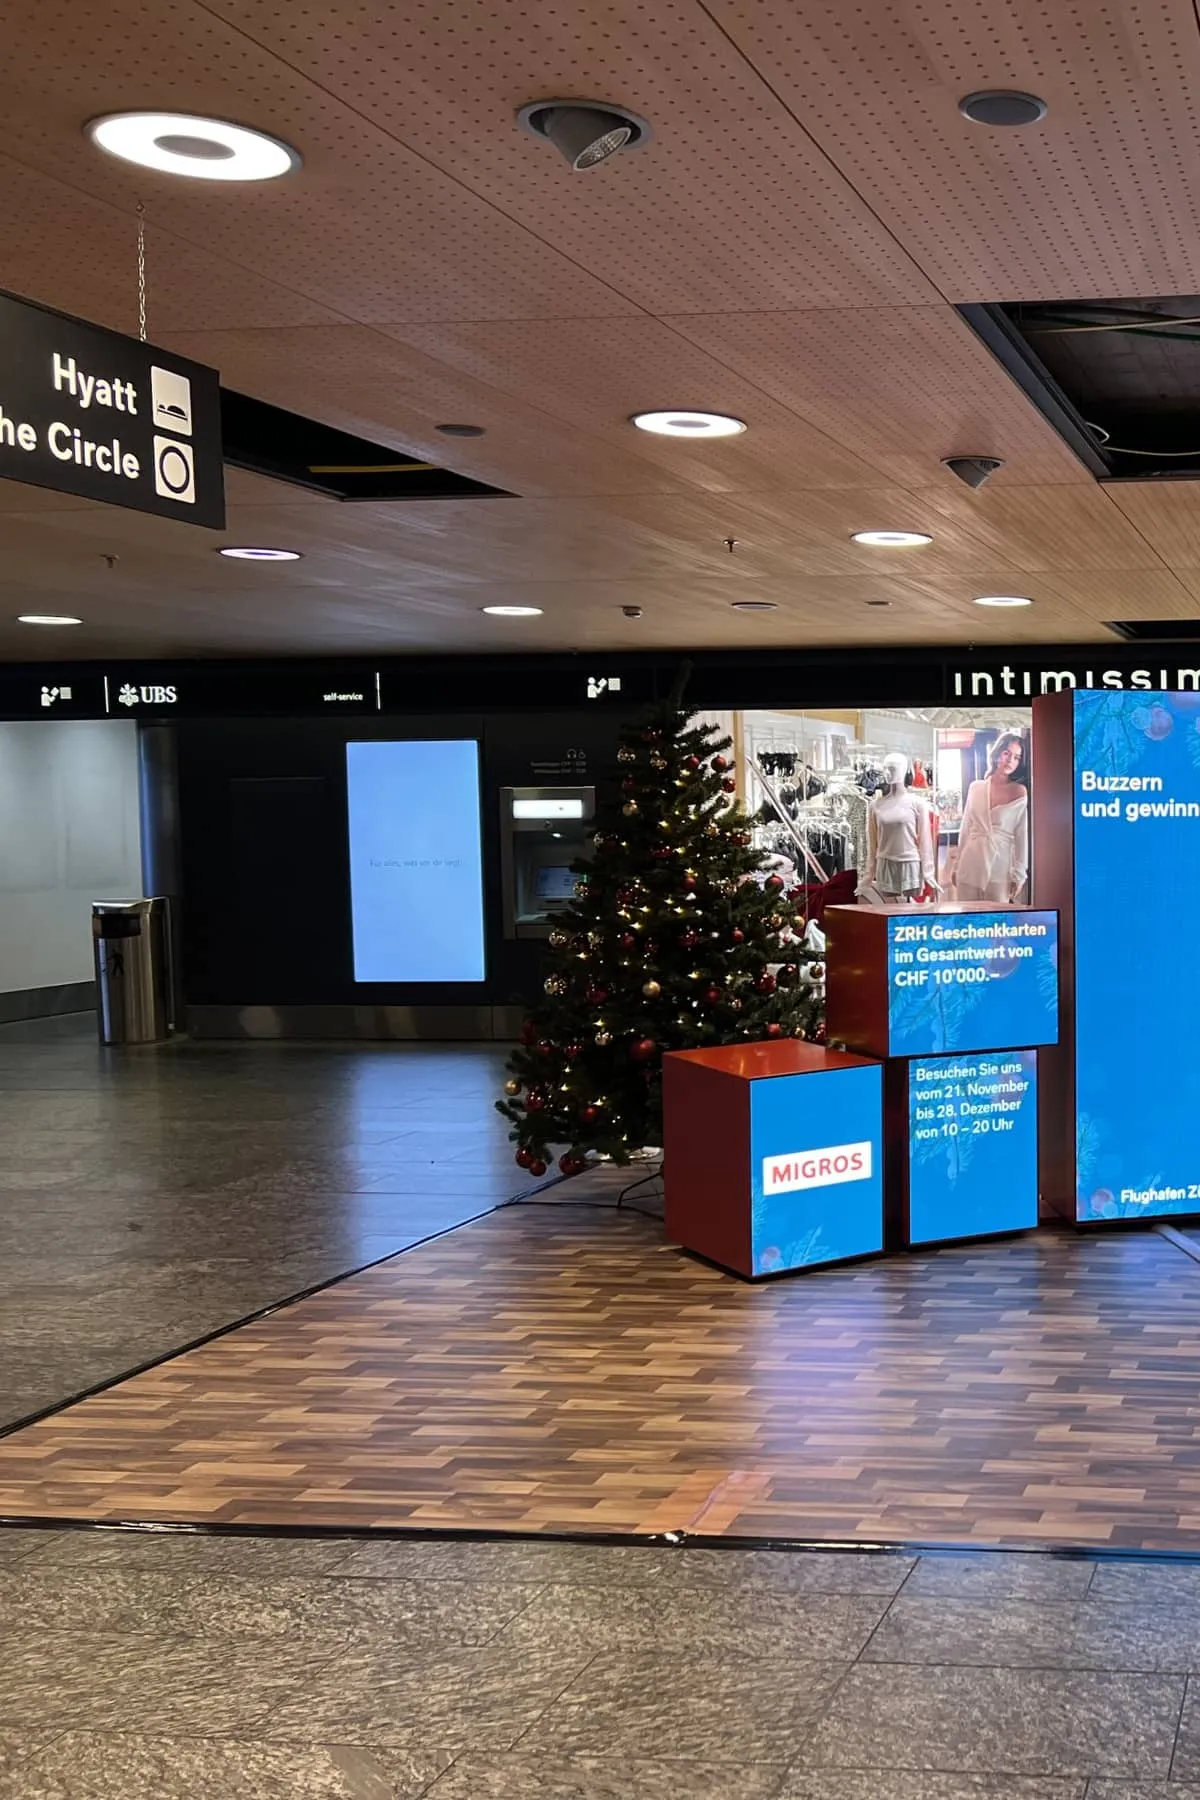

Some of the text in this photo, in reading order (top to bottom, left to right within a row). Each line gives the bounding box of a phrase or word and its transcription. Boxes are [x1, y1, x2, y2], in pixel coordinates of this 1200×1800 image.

[53, 353, 137, 415] Hyatt
[0, 405, 140, 479] he Circle
[140, 686, 177, 703] UBS
[323, 692, 363, 701] self-service
[1081, 771, 1163, 791] Buzzern
[1081, 797, 1120, 817] und
[894, 922, 1047, 942] ZRH Geschenkkarten
[894, 945, 1033, 963] im Gesamtwert von
[894, 970, 929, 986] CHF
[916, 1063, 1022, 1081] Besuchen Sie uns
[916, 1080, 1029, 1101] vom 21. November
[916, 1100, 1021, 1120] bis 28. Dezember
[916, 1128, 938, 1140] von
[942, 1123, 958, 1137] 10
[972, 1119, 989, 1134] 20
[992, 1118, 1014, 1131] Uhr
[772, 1152, 863, 1184] MIGROS
[1121, 1186, 1185, 1205] Flughafen
